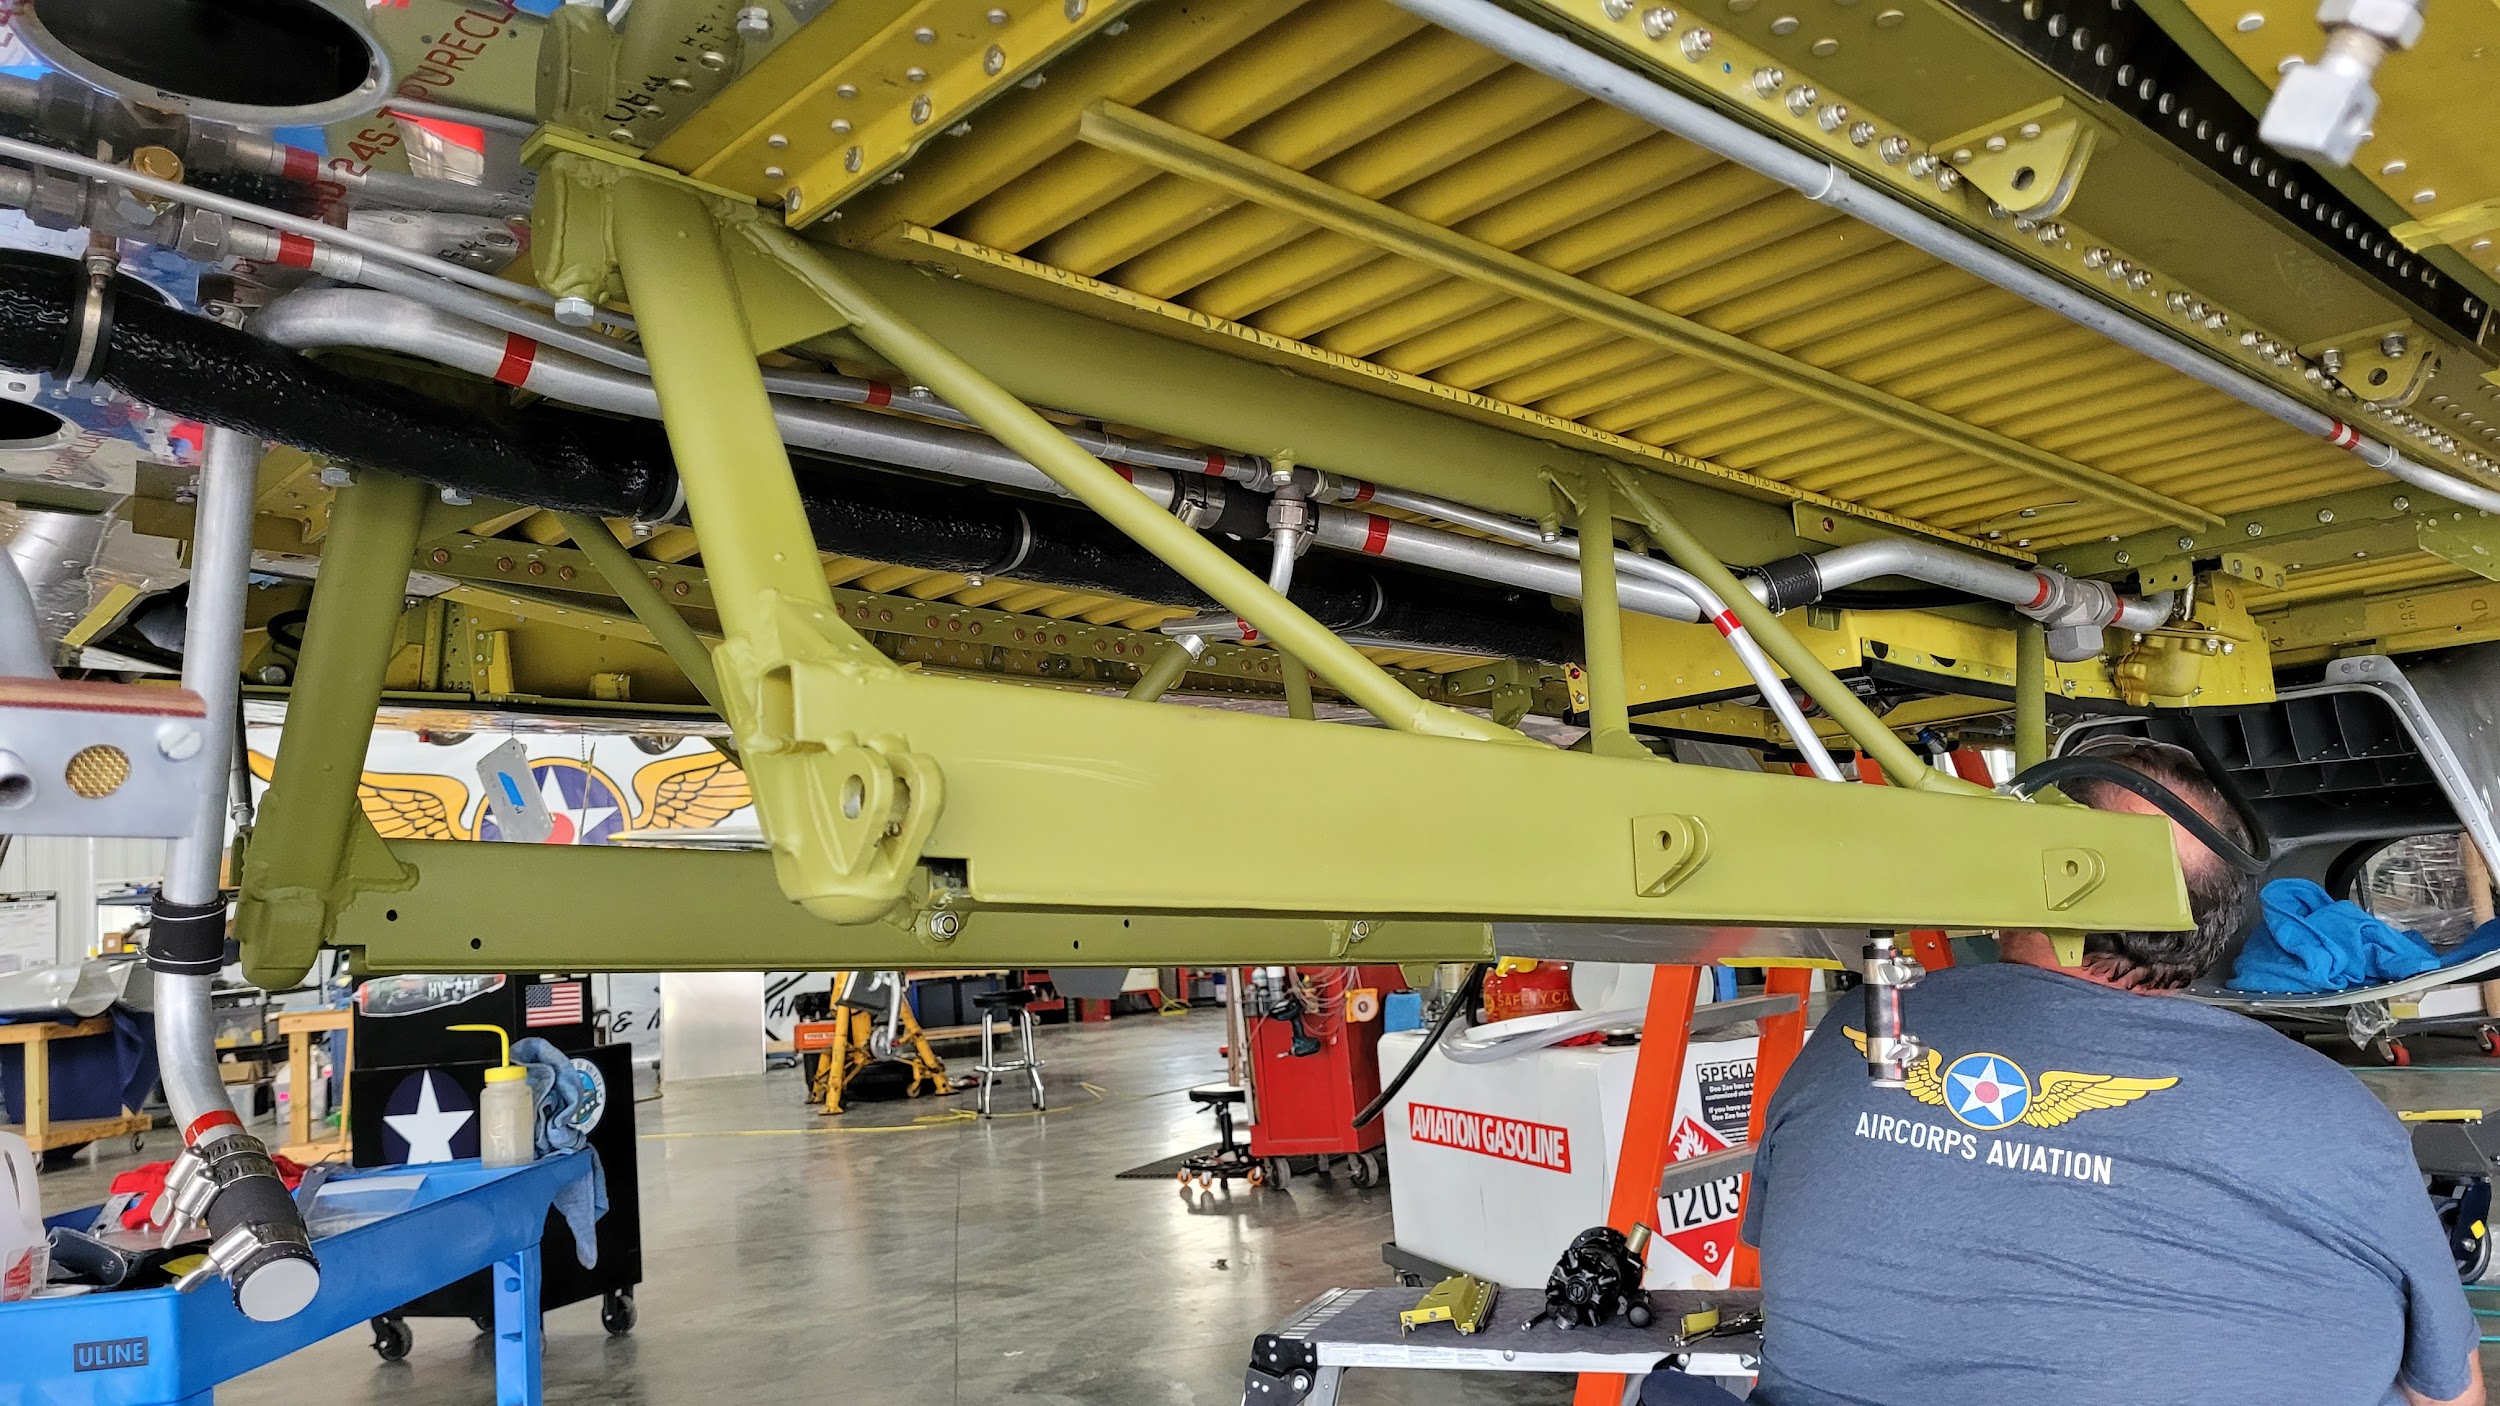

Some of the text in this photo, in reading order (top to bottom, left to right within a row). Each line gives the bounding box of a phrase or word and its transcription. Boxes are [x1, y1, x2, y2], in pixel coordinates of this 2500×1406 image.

[1411, 1106, 1566, 1168] AVIATION GASOLINE
[1855, 1111, 2112, 1185] AIRCORPS AVIATION
[1661, 1174, 1740, 1229] 1203
[1703, 1241, 1719, 1263] 3
[78, 1342, 145, 1368] ULINE
